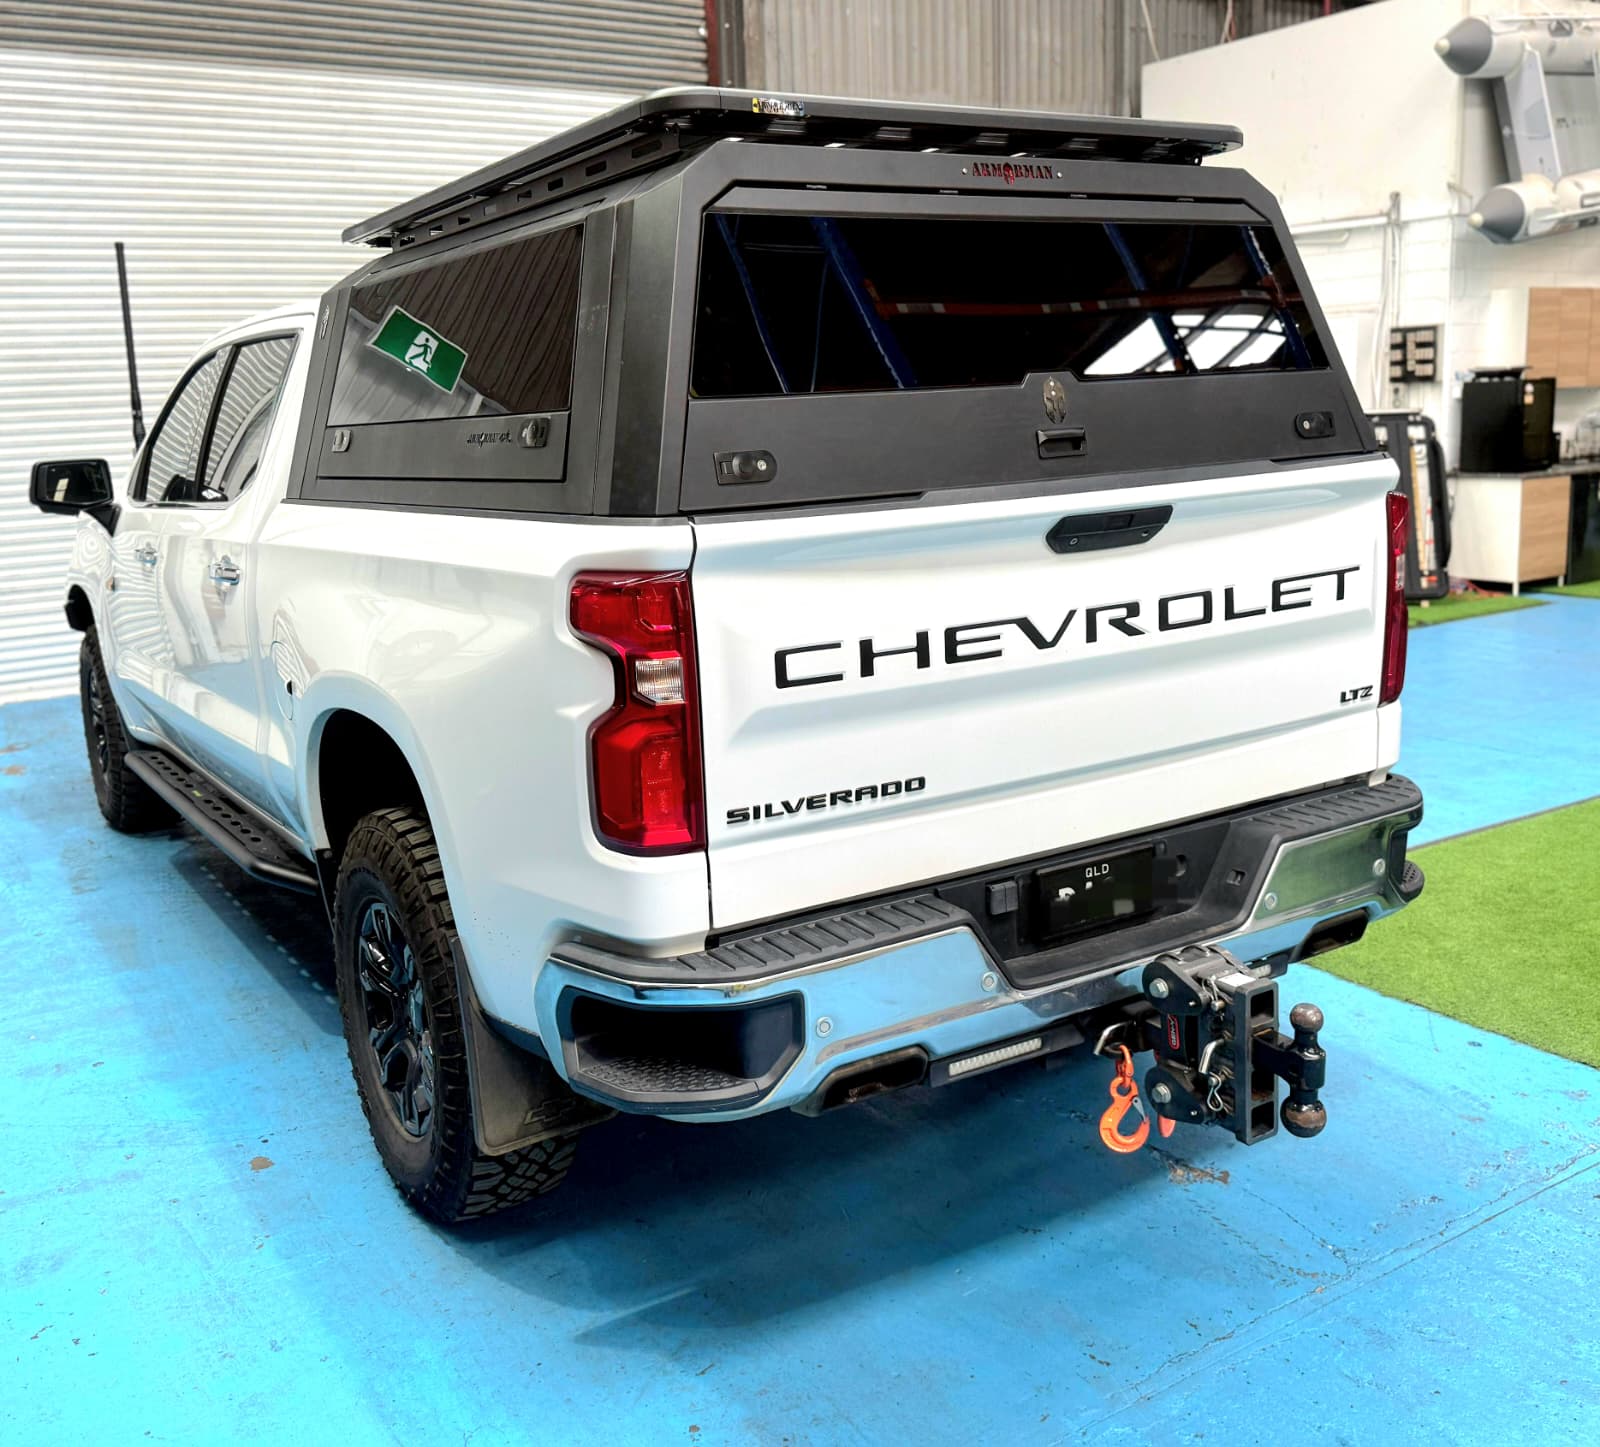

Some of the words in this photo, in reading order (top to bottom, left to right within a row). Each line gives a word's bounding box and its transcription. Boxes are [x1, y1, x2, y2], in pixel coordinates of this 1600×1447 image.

[774, 566, 1360, 689] CHEVROLET
[1340, 684, 1373, 703] LTZ
[726, 776, 926, 825] SILVERADO
[1085, 863, 1110, 878] QLD
